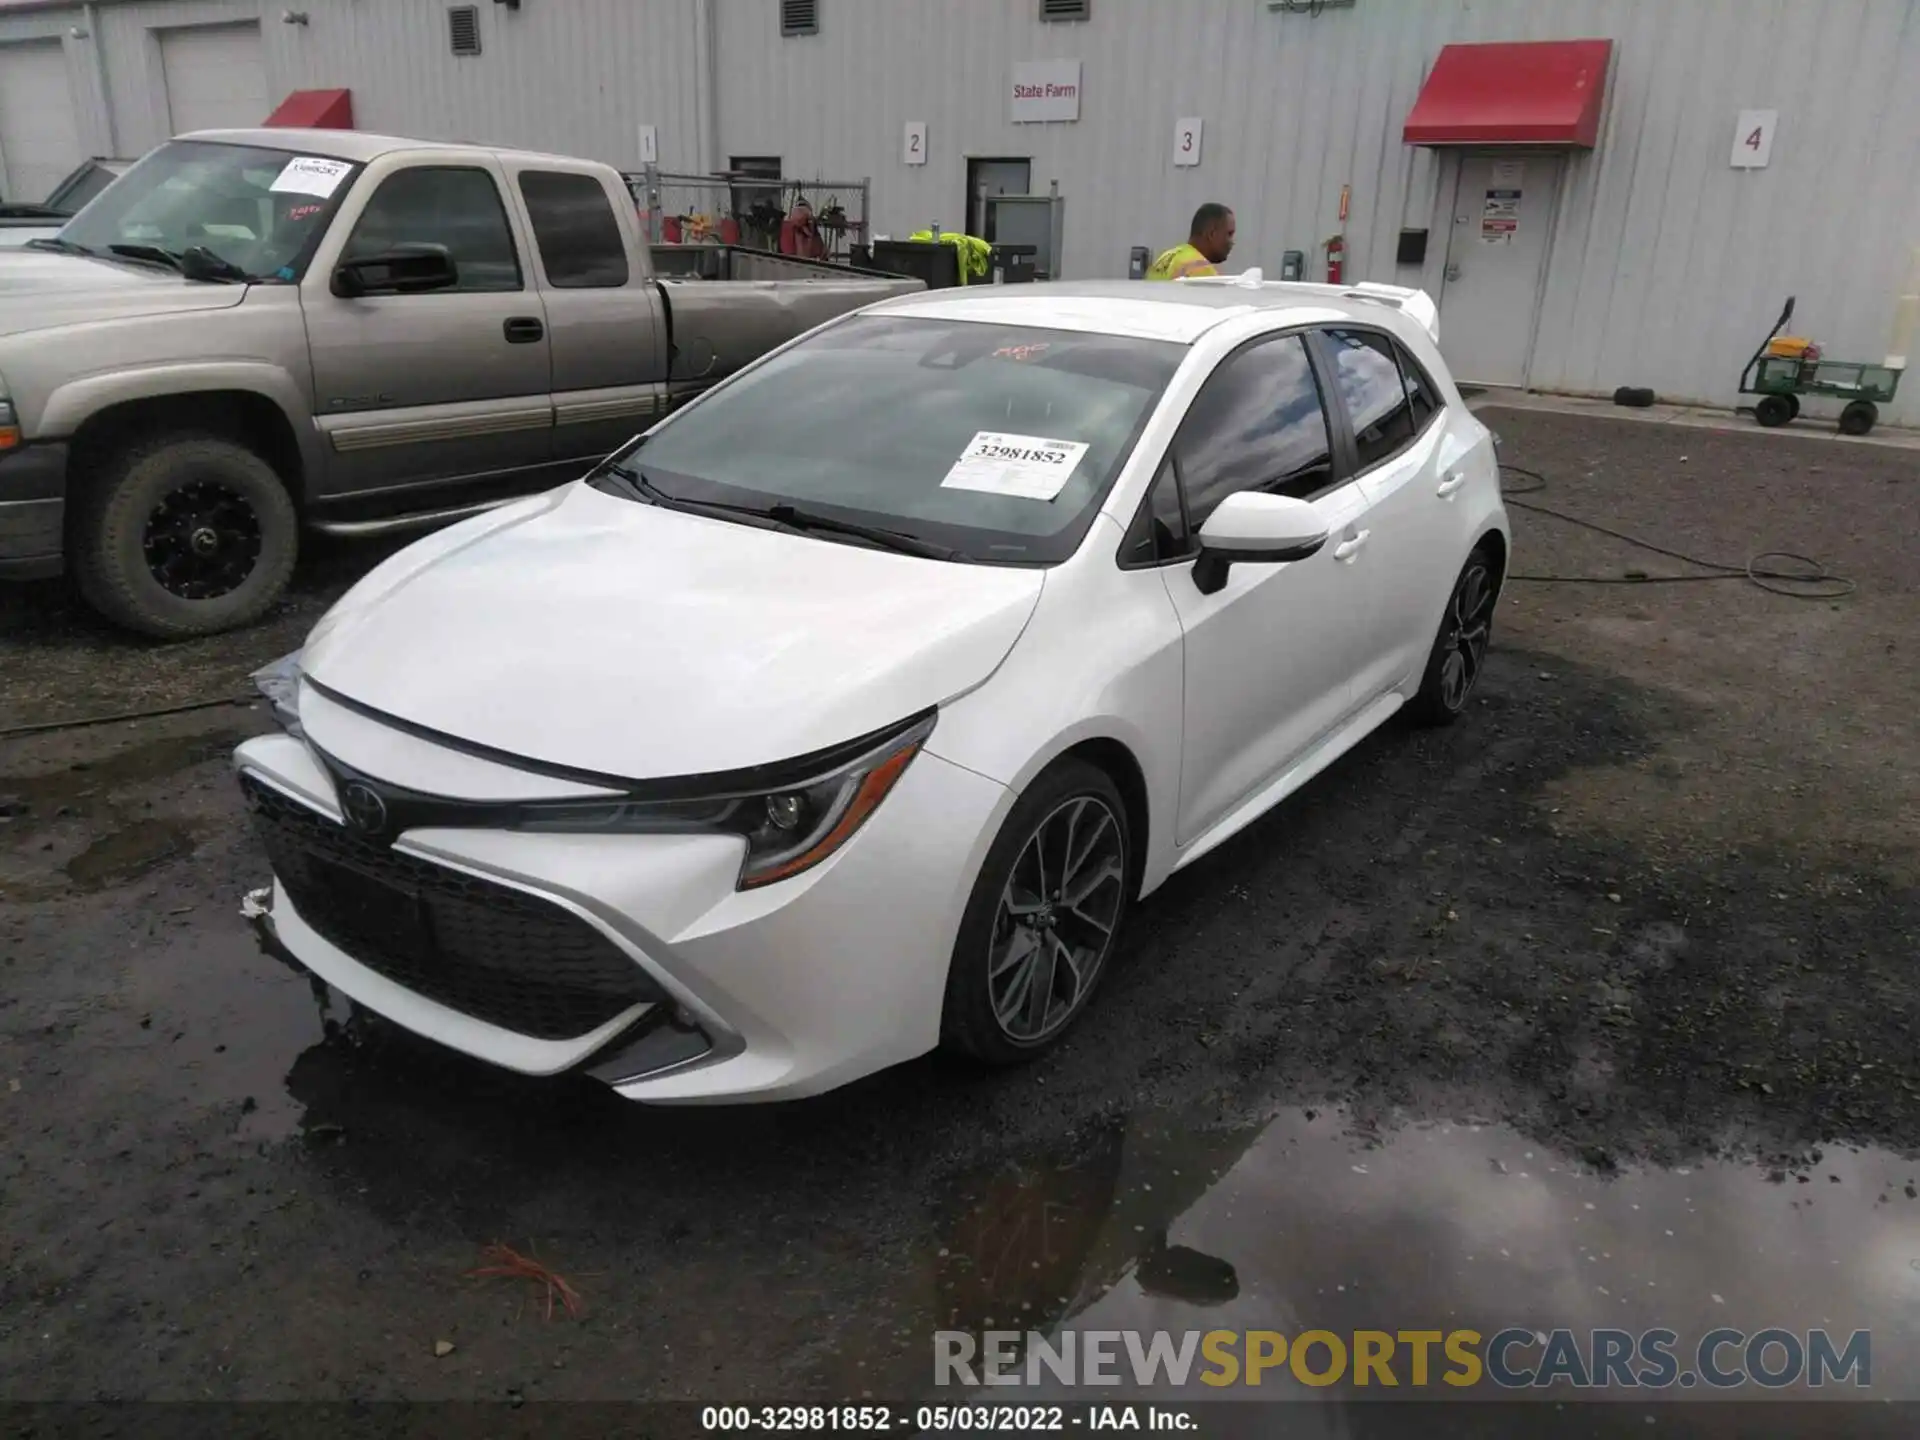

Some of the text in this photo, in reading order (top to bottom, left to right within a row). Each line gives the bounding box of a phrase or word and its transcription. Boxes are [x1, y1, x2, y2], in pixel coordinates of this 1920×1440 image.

[1013, 83, 1076, 98] State Farm
[910, 133, 920, 152] 2
[1182, 131, 1192, 152] 3
[1745, 125, 1762, 151] 4
[976, 444, 1066, 464] 32981852
